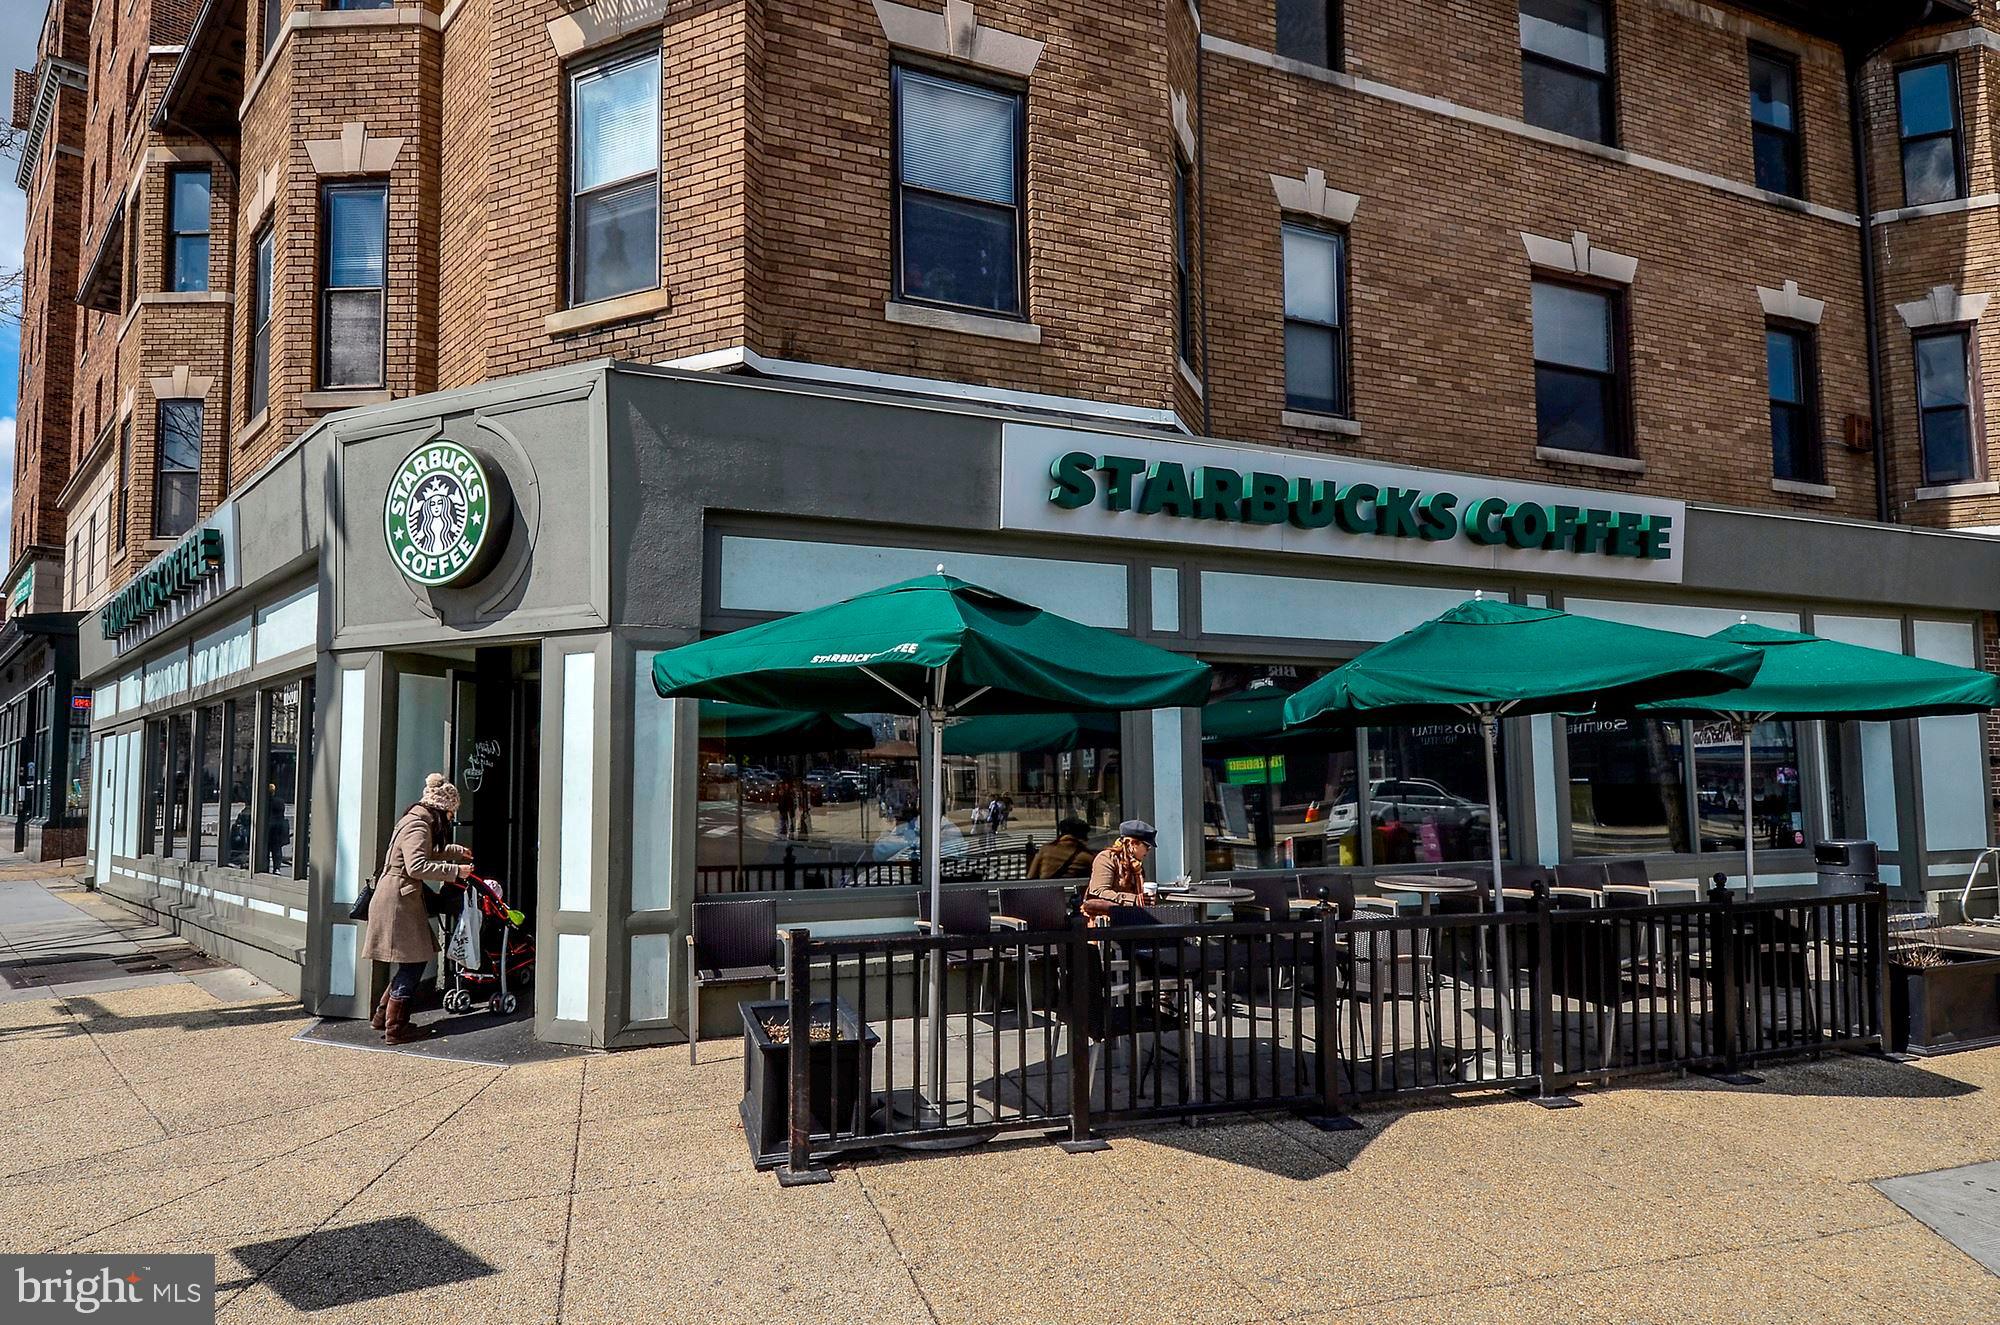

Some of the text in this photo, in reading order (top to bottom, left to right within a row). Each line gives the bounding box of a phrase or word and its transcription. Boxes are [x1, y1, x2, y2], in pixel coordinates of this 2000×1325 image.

[391, 449, 483, 516] STARBUCKS
[1049, 451, 1672, 560] STARBUCKS COFFEE
[157, 528, 221, 601] COFFEE
[401, 535, 474, 577] COFFEE
